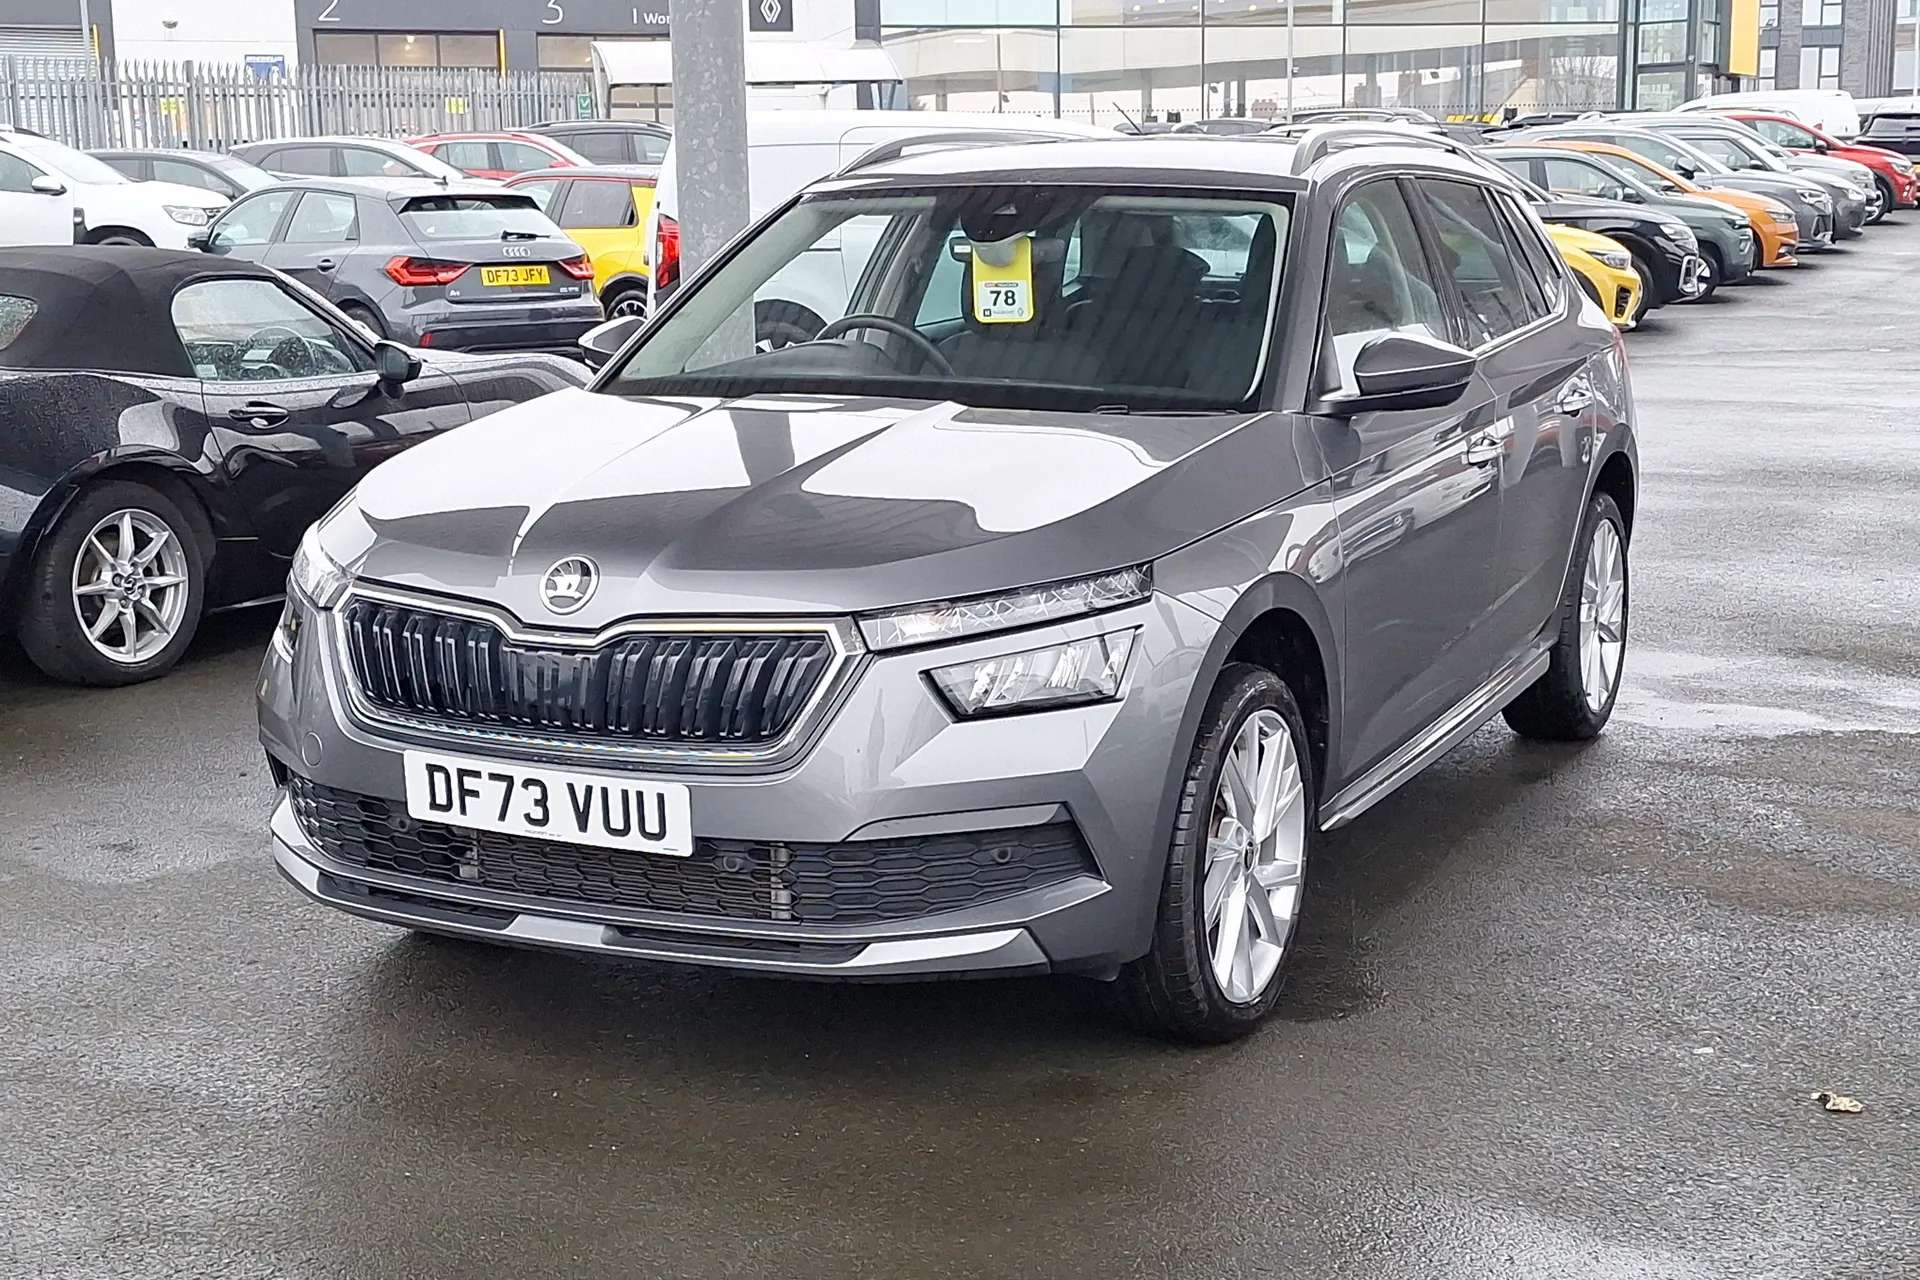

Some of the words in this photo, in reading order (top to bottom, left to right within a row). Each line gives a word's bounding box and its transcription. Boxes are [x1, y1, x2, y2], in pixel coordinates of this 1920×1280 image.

[318, 0, 341, 21] 2
[541, 0, 564, 24] 3
[486, 269, 519, 283] DF73
[523, 268, 543, 282] JFY
[989, 289, 1016, 307] 78
[425, 762, 550, 827] DF73
[566, 781, 667, 842] VUU
